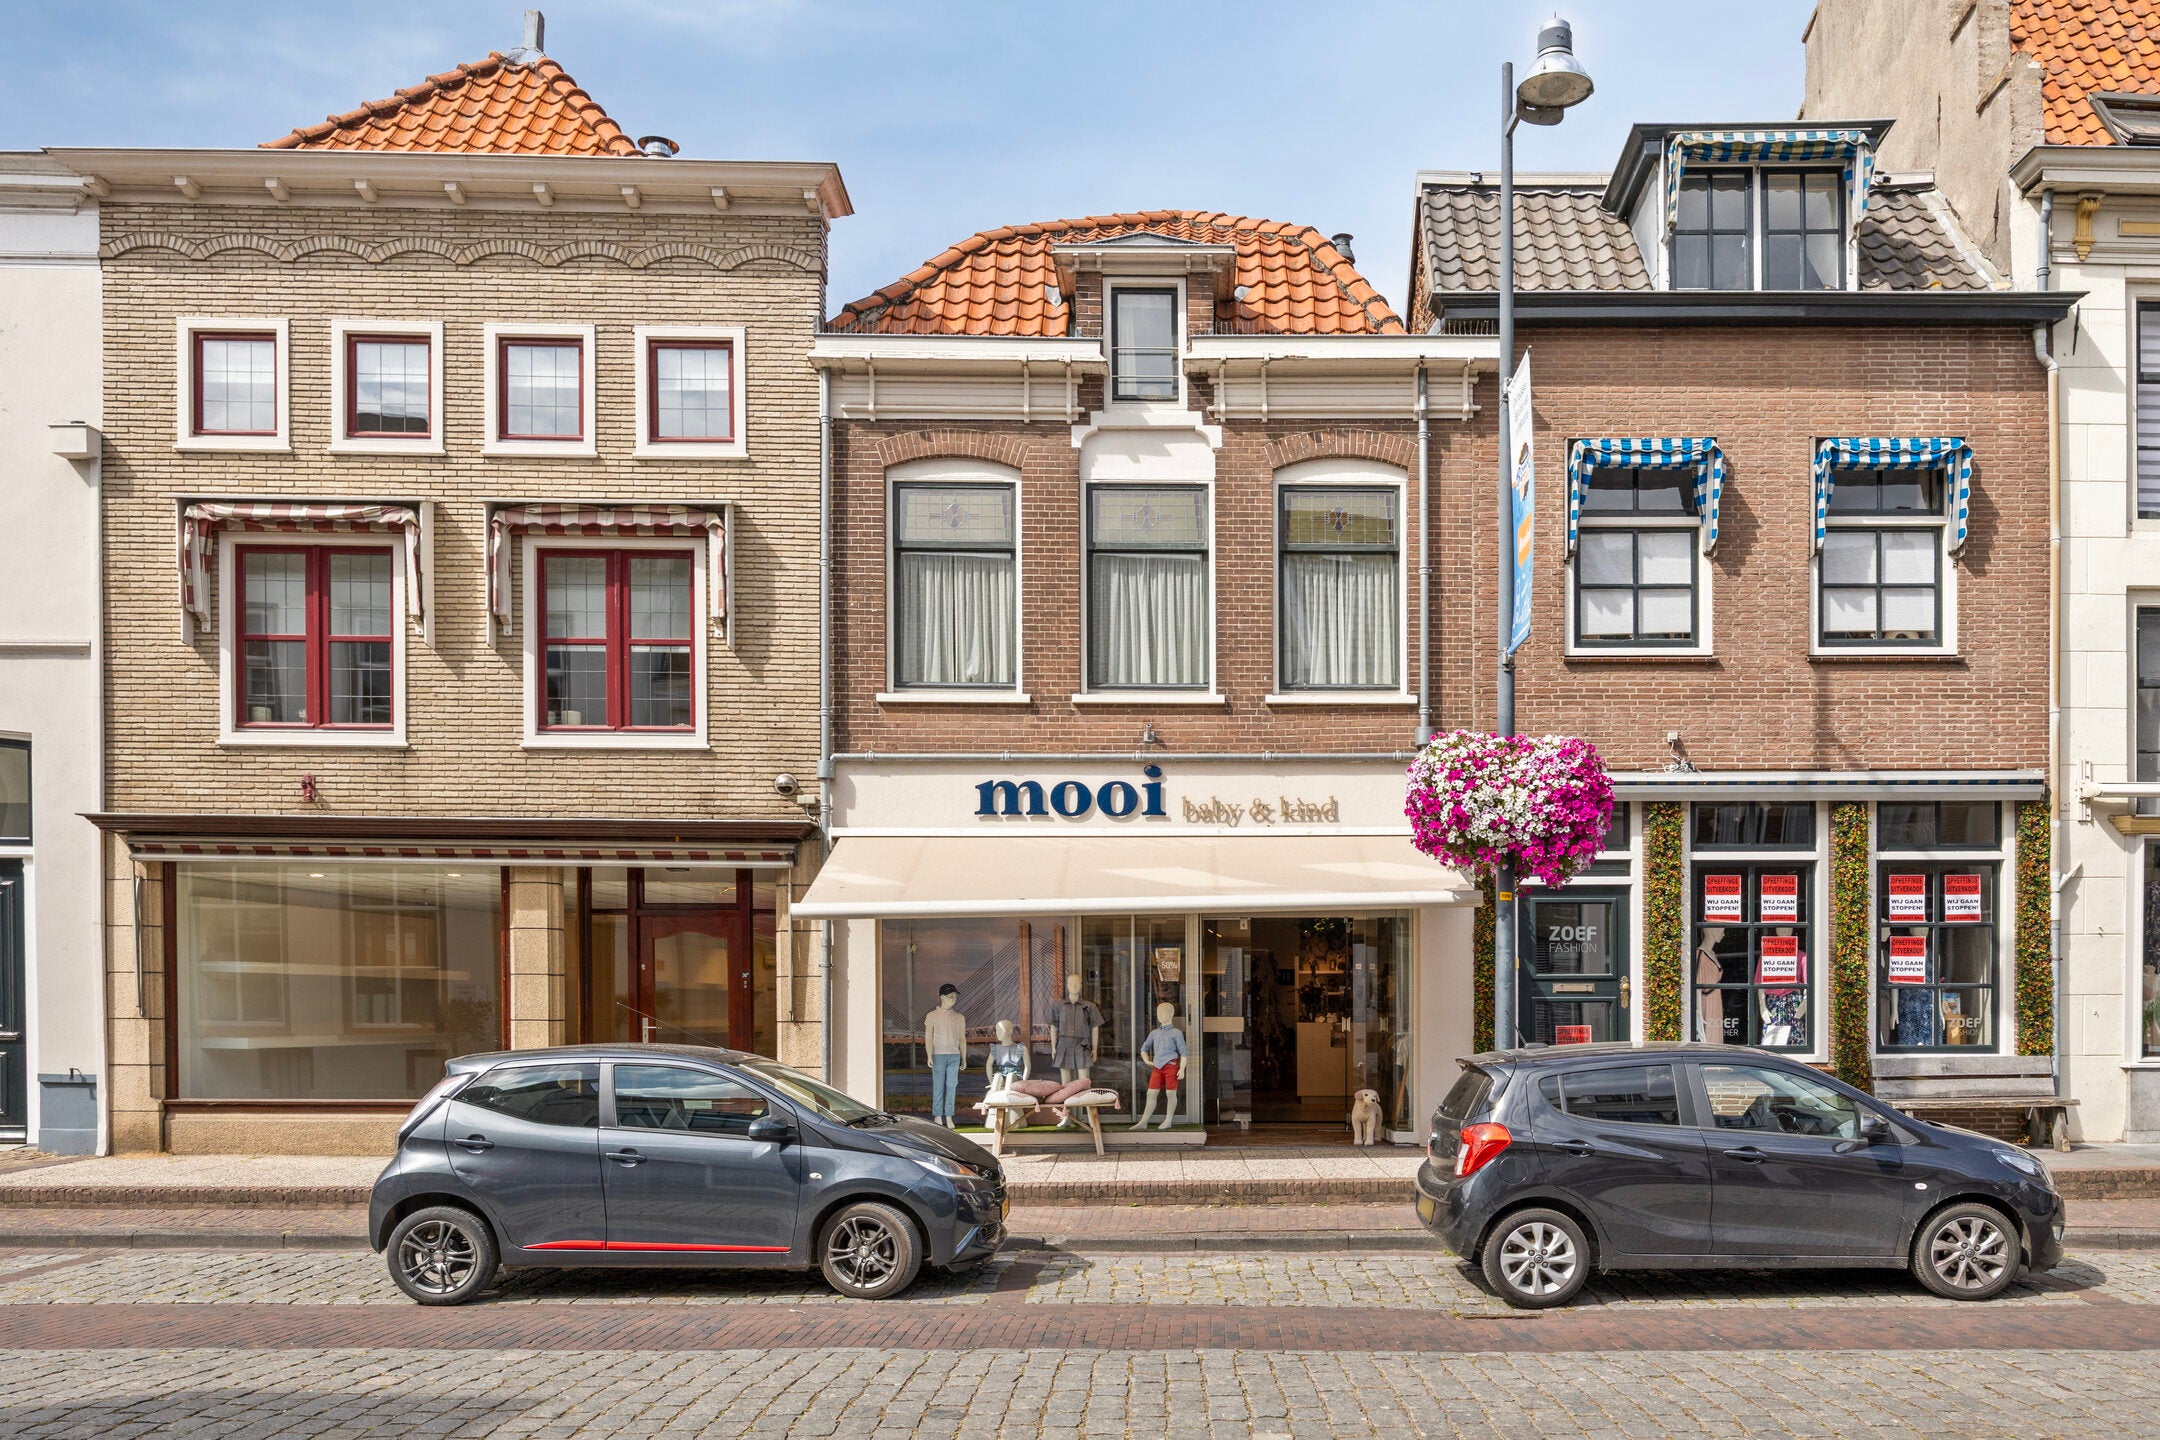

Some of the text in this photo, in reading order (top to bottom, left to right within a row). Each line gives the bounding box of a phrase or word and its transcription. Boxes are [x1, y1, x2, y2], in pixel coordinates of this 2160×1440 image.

[975, 765, 1337, 826] mooi baby & kind
[1549, 926, 1597, 941] ZOEF
[1549, 943, 1597, 953] FASHION
[1948, 1018, 1981, 1028] ZOEF
